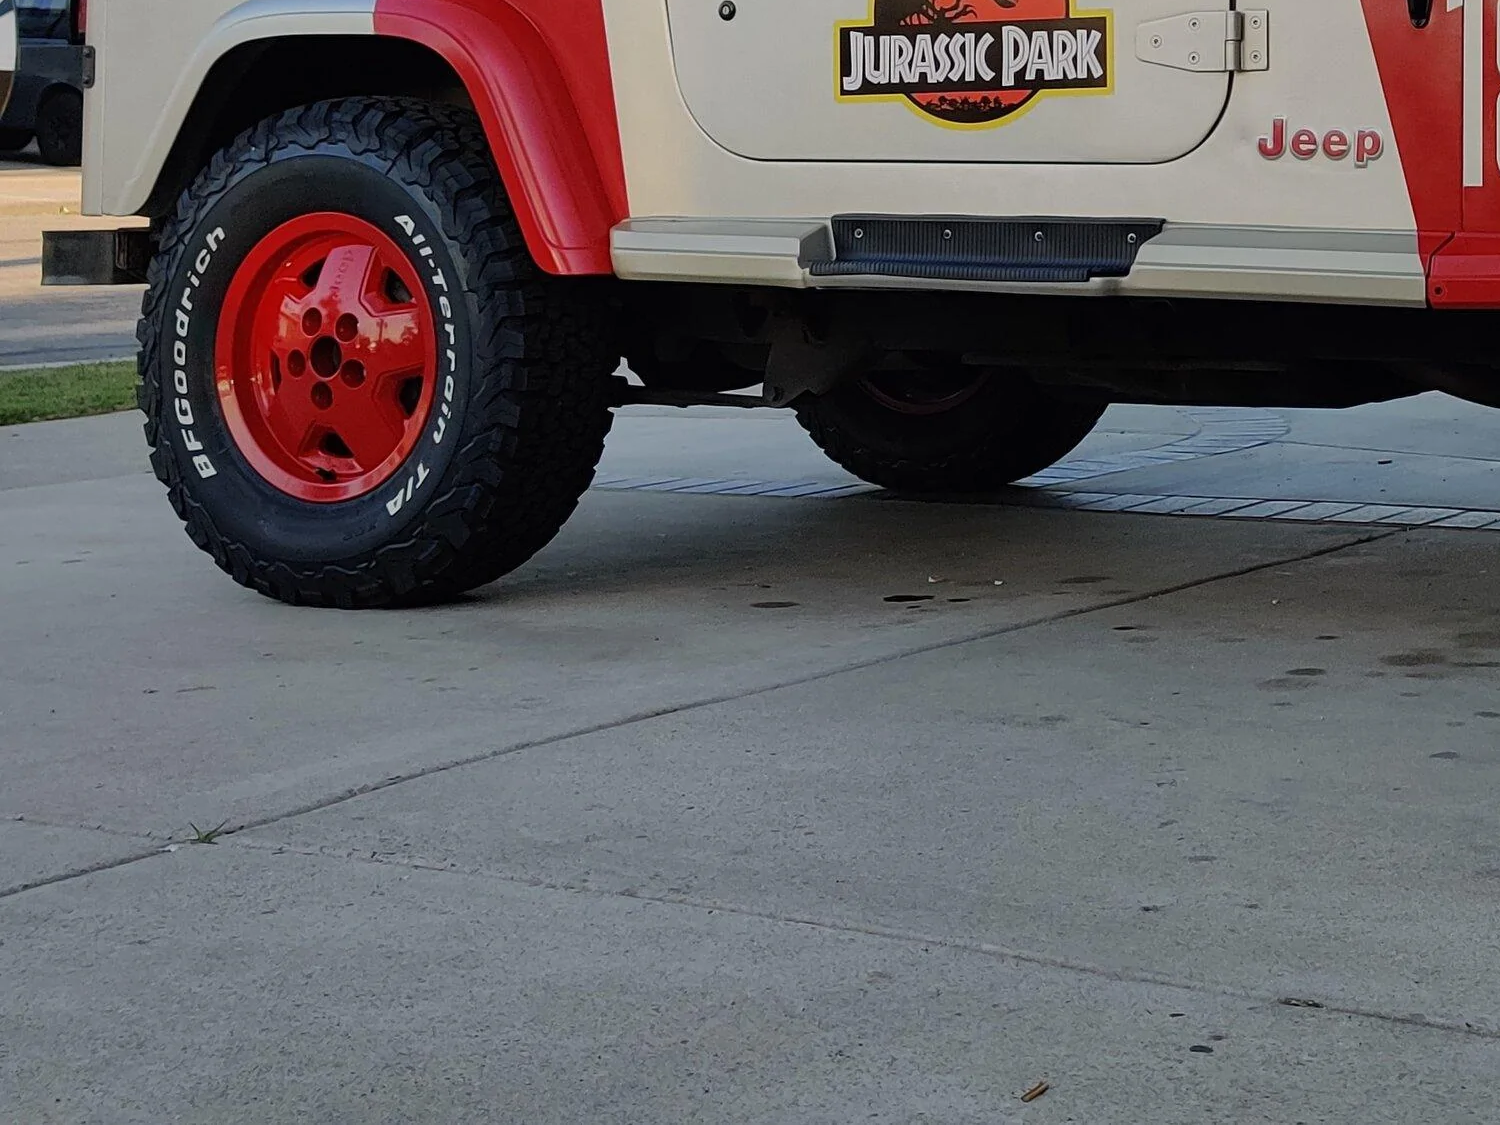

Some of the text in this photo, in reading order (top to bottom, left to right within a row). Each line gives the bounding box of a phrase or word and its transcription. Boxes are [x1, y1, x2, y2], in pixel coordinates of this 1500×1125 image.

[843, 25, 1104, 92] JURASSIC PARK
[1257, 115, 1383, 169] Jeep
[174, 225, 226, 479] BFGoodrich
[385, 213, 459, 517] All-Terrain T/A
